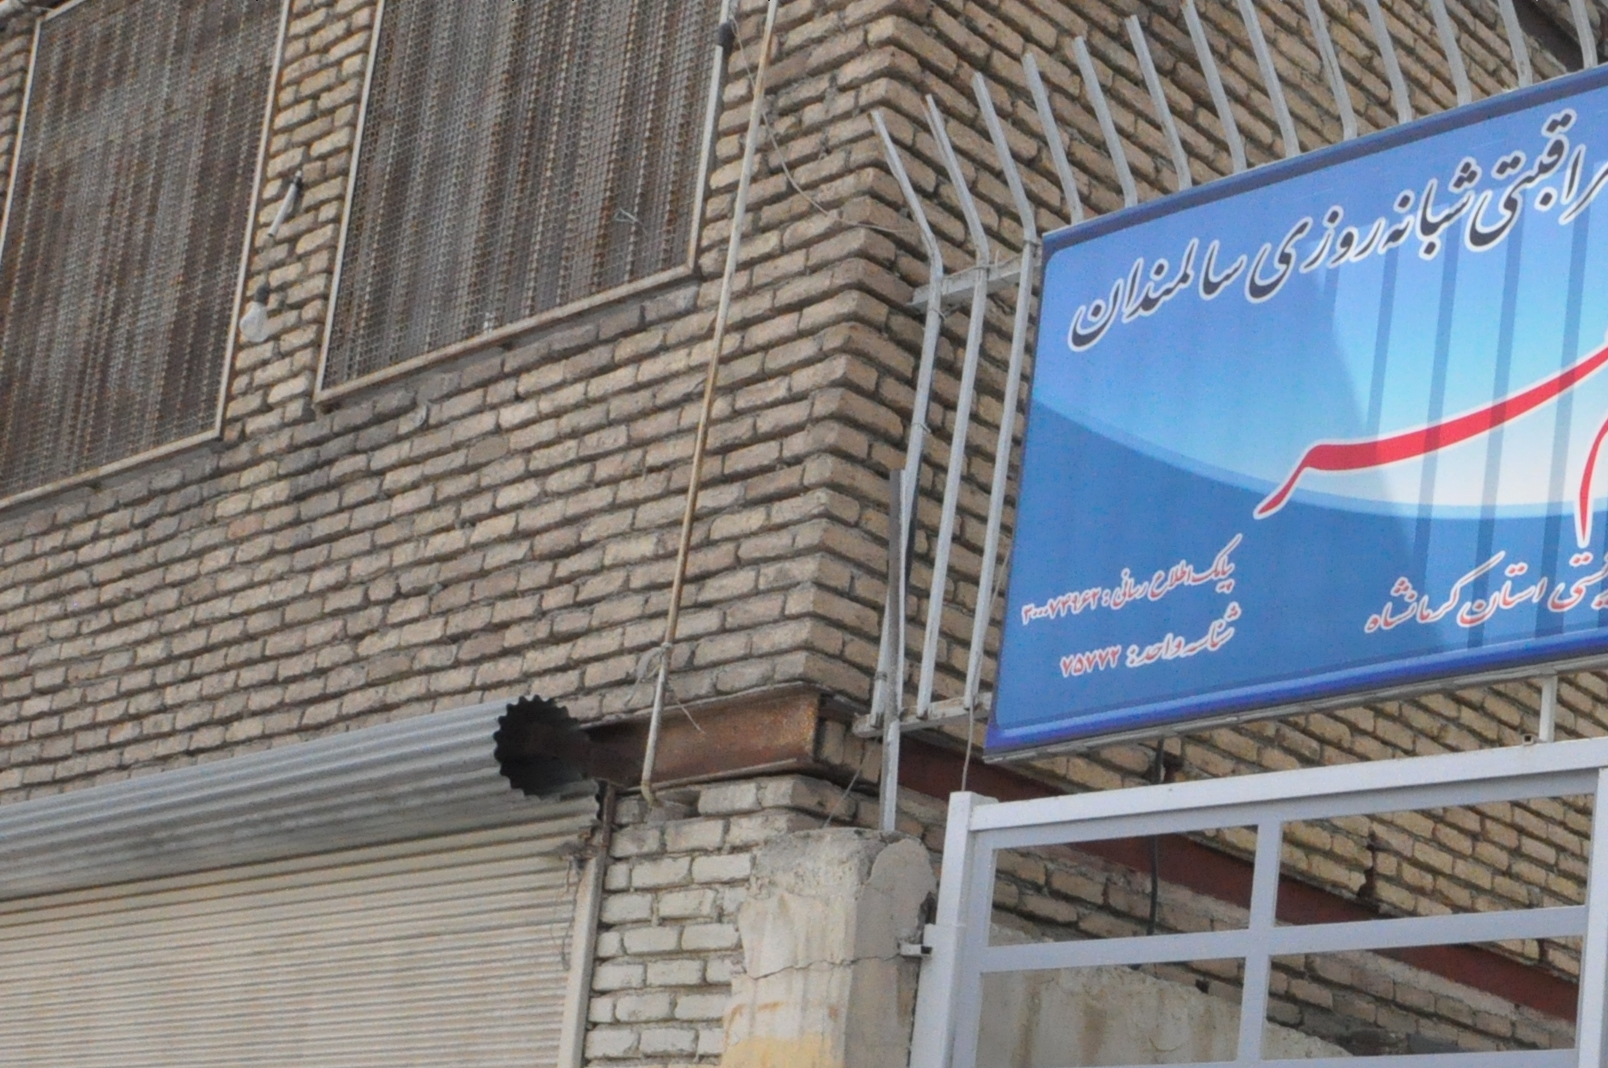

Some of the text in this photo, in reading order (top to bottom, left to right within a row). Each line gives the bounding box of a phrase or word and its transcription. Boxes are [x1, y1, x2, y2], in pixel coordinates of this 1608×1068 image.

[1379, 157, 1480, 259] شبانه
[1068, 239, 1247, 352] سالمندان
[1148, 560, 1193, 601] اطلاع
[1365, 550, 1505, 633] کرمانشاه
[1456, 562, 1548, 628] استان
[1181, 601, 1242, 656] شناسه
